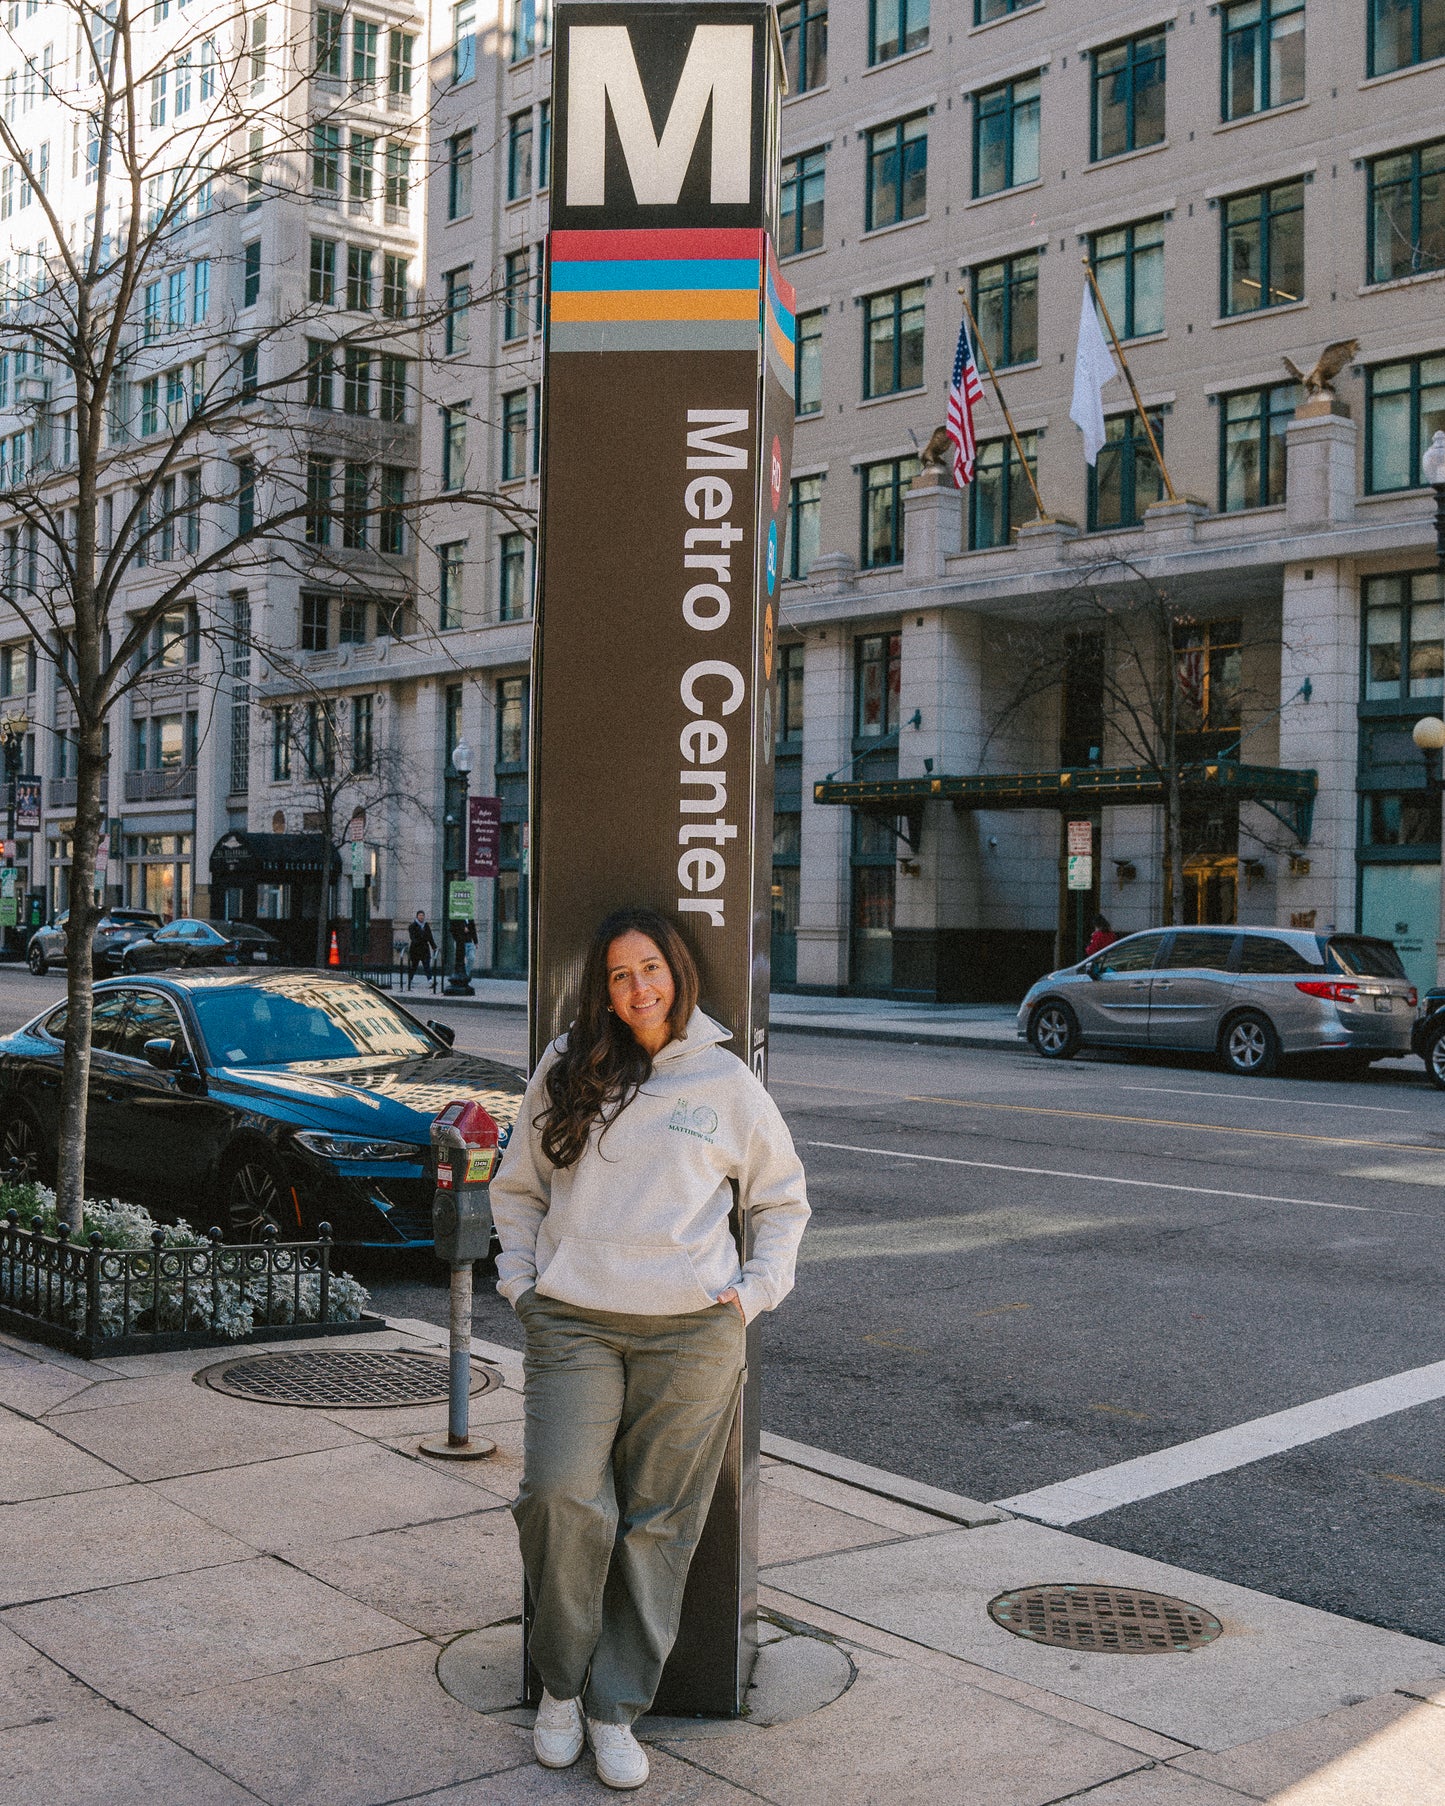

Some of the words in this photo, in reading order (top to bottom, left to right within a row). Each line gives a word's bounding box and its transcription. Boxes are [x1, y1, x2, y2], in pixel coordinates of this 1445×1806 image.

[566, 24, 753, 206] M
[682, 409, 749, 631] Metro
[771, 454, 781, 493] RD
[767, 540, 776, 577] BL
[677, 660, 745, 927] Center
[668, 1124, 703, 1138] MATTHEW
